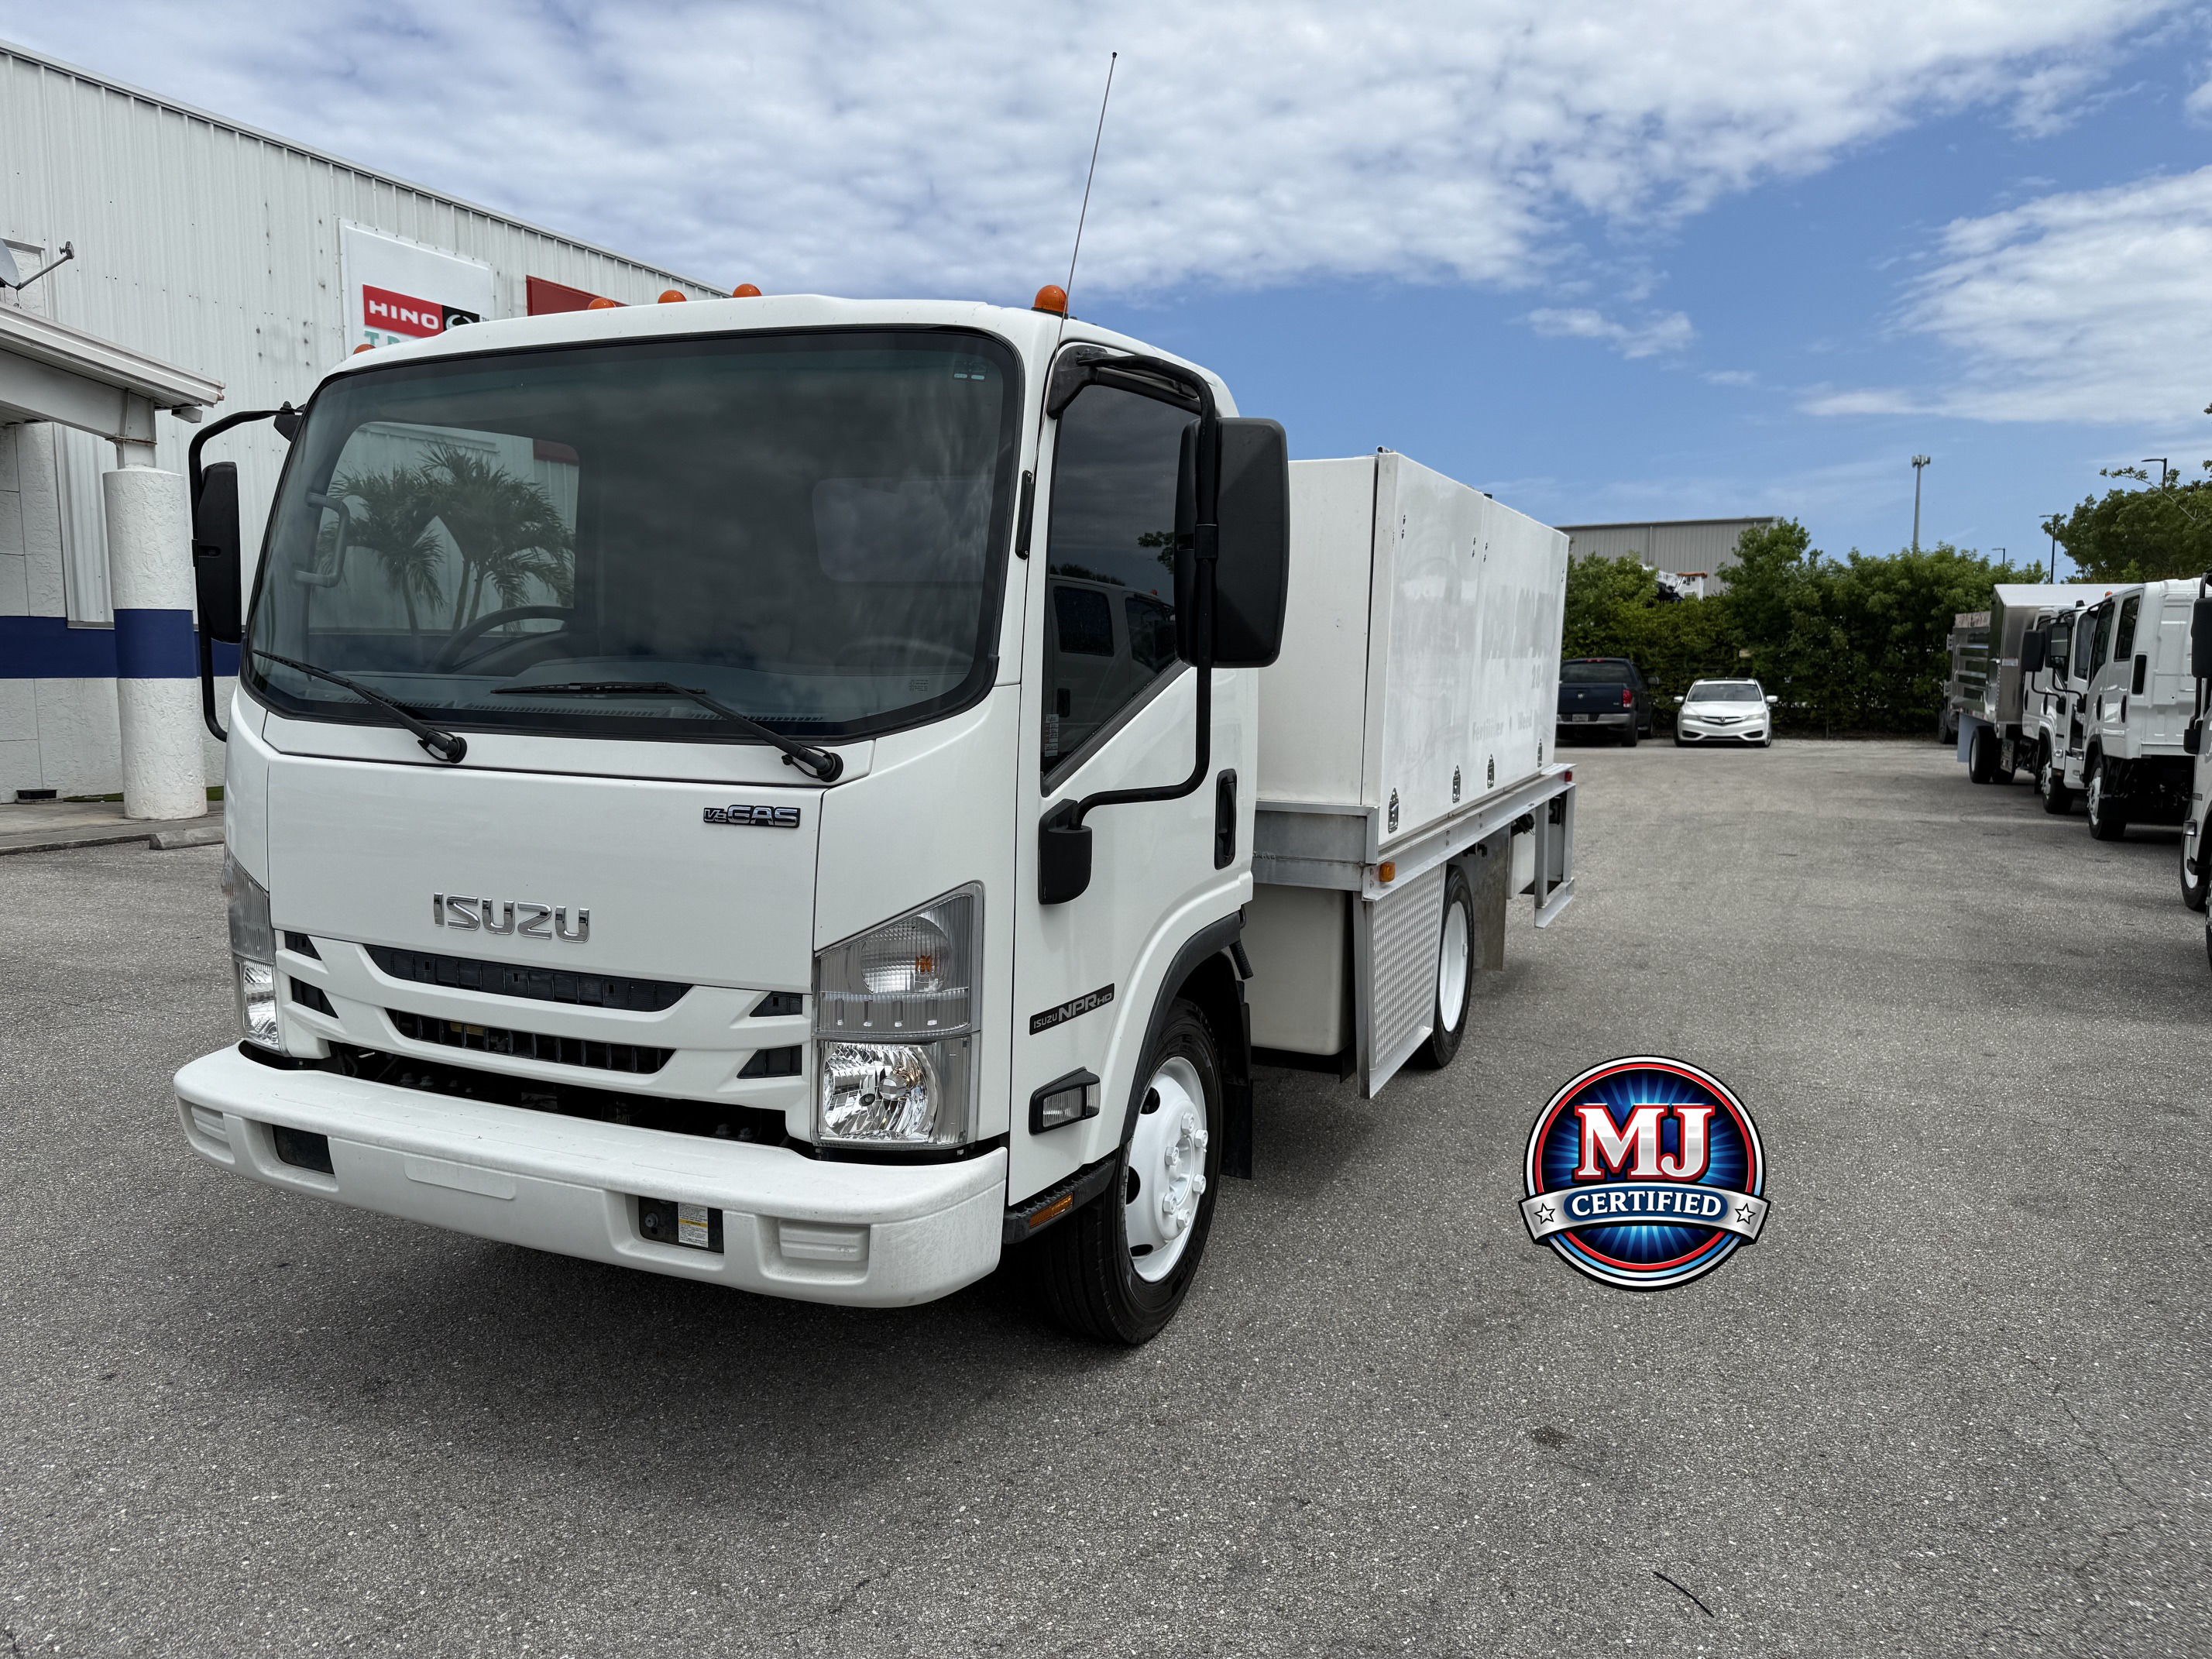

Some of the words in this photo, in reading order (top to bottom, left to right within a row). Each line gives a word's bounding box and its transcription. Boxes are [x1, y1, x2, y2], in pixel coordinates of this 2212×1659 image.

[369, 300, 439, 330] HINO
[728, 805, 798, 827] GAS
[433, 891, 590, 943] ISUZU
[1033, 1012, 1058, 1029] ISUZU
[1058, 994, 1097, 1022] NPR
[1097, 992, 1112, 1005] HD
